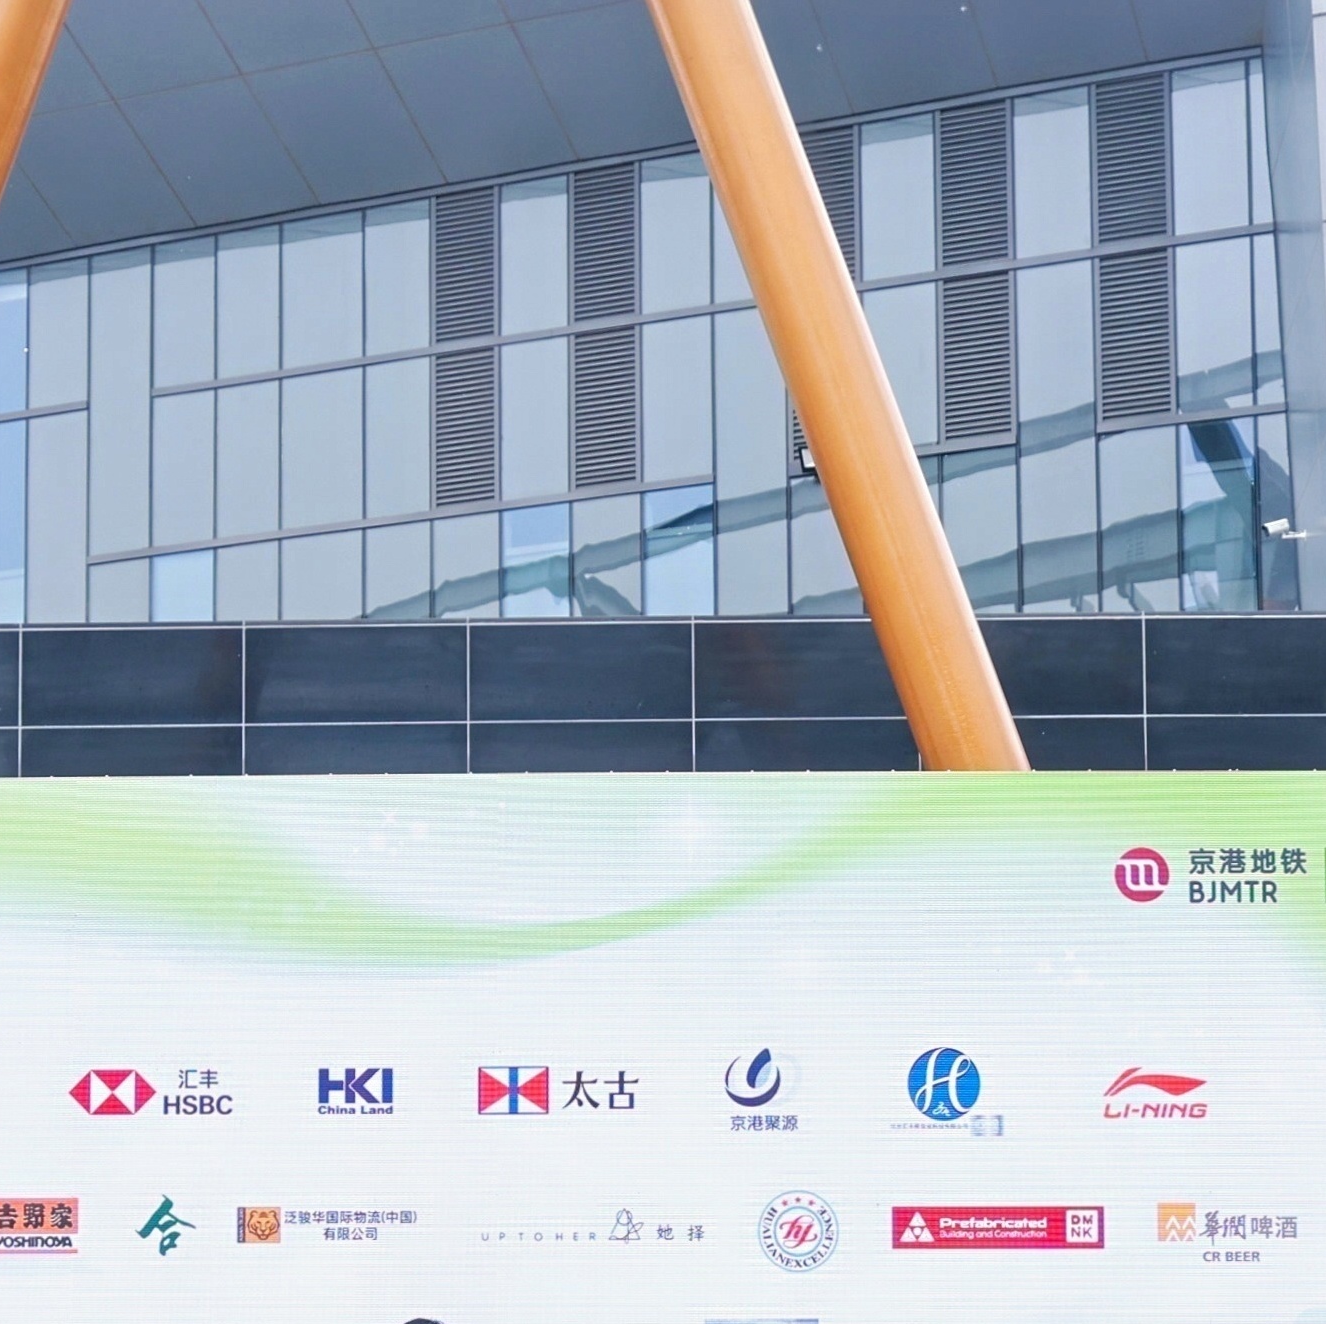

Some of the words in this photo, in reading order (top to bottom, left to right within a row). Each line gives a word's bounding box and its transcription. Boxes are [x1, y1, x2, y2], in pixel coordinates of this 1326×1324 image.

[1188, 847, 1308, 875] 京港地铁
[1188, 880, 1279, 904] BJMTR
[178, 1068, 219, 1090] 汇丰
[318, 1068, 394, 1105] HKI
[561, 1070, 640, 1110] 太古
[162, 1094, 234, 1116] HSBC
[317, 1105, 356, 1116] China
[360, 1105, 394, 1116] Land
[1103, 1102, 1209, 1120] LI-NING
[729, 1114, 799, 1132] 京港聚源
[134, 1194, 197, 1257] 合
[283, 1209, 418, 1225] 泛骏华国际物流(中国)
[939, 1216, 1048, 1230] Prefabricated
[322, 1226, 378, 1242] 有限公司
[939, 1229, 974, 1240] Building
[975, 1229, 993, 1239] and
[994, 1229, 1048, 1239] Construction
[1203, 1251, 1221, 1262] CR
[1225, 1251, 1260, 1262] BEER
